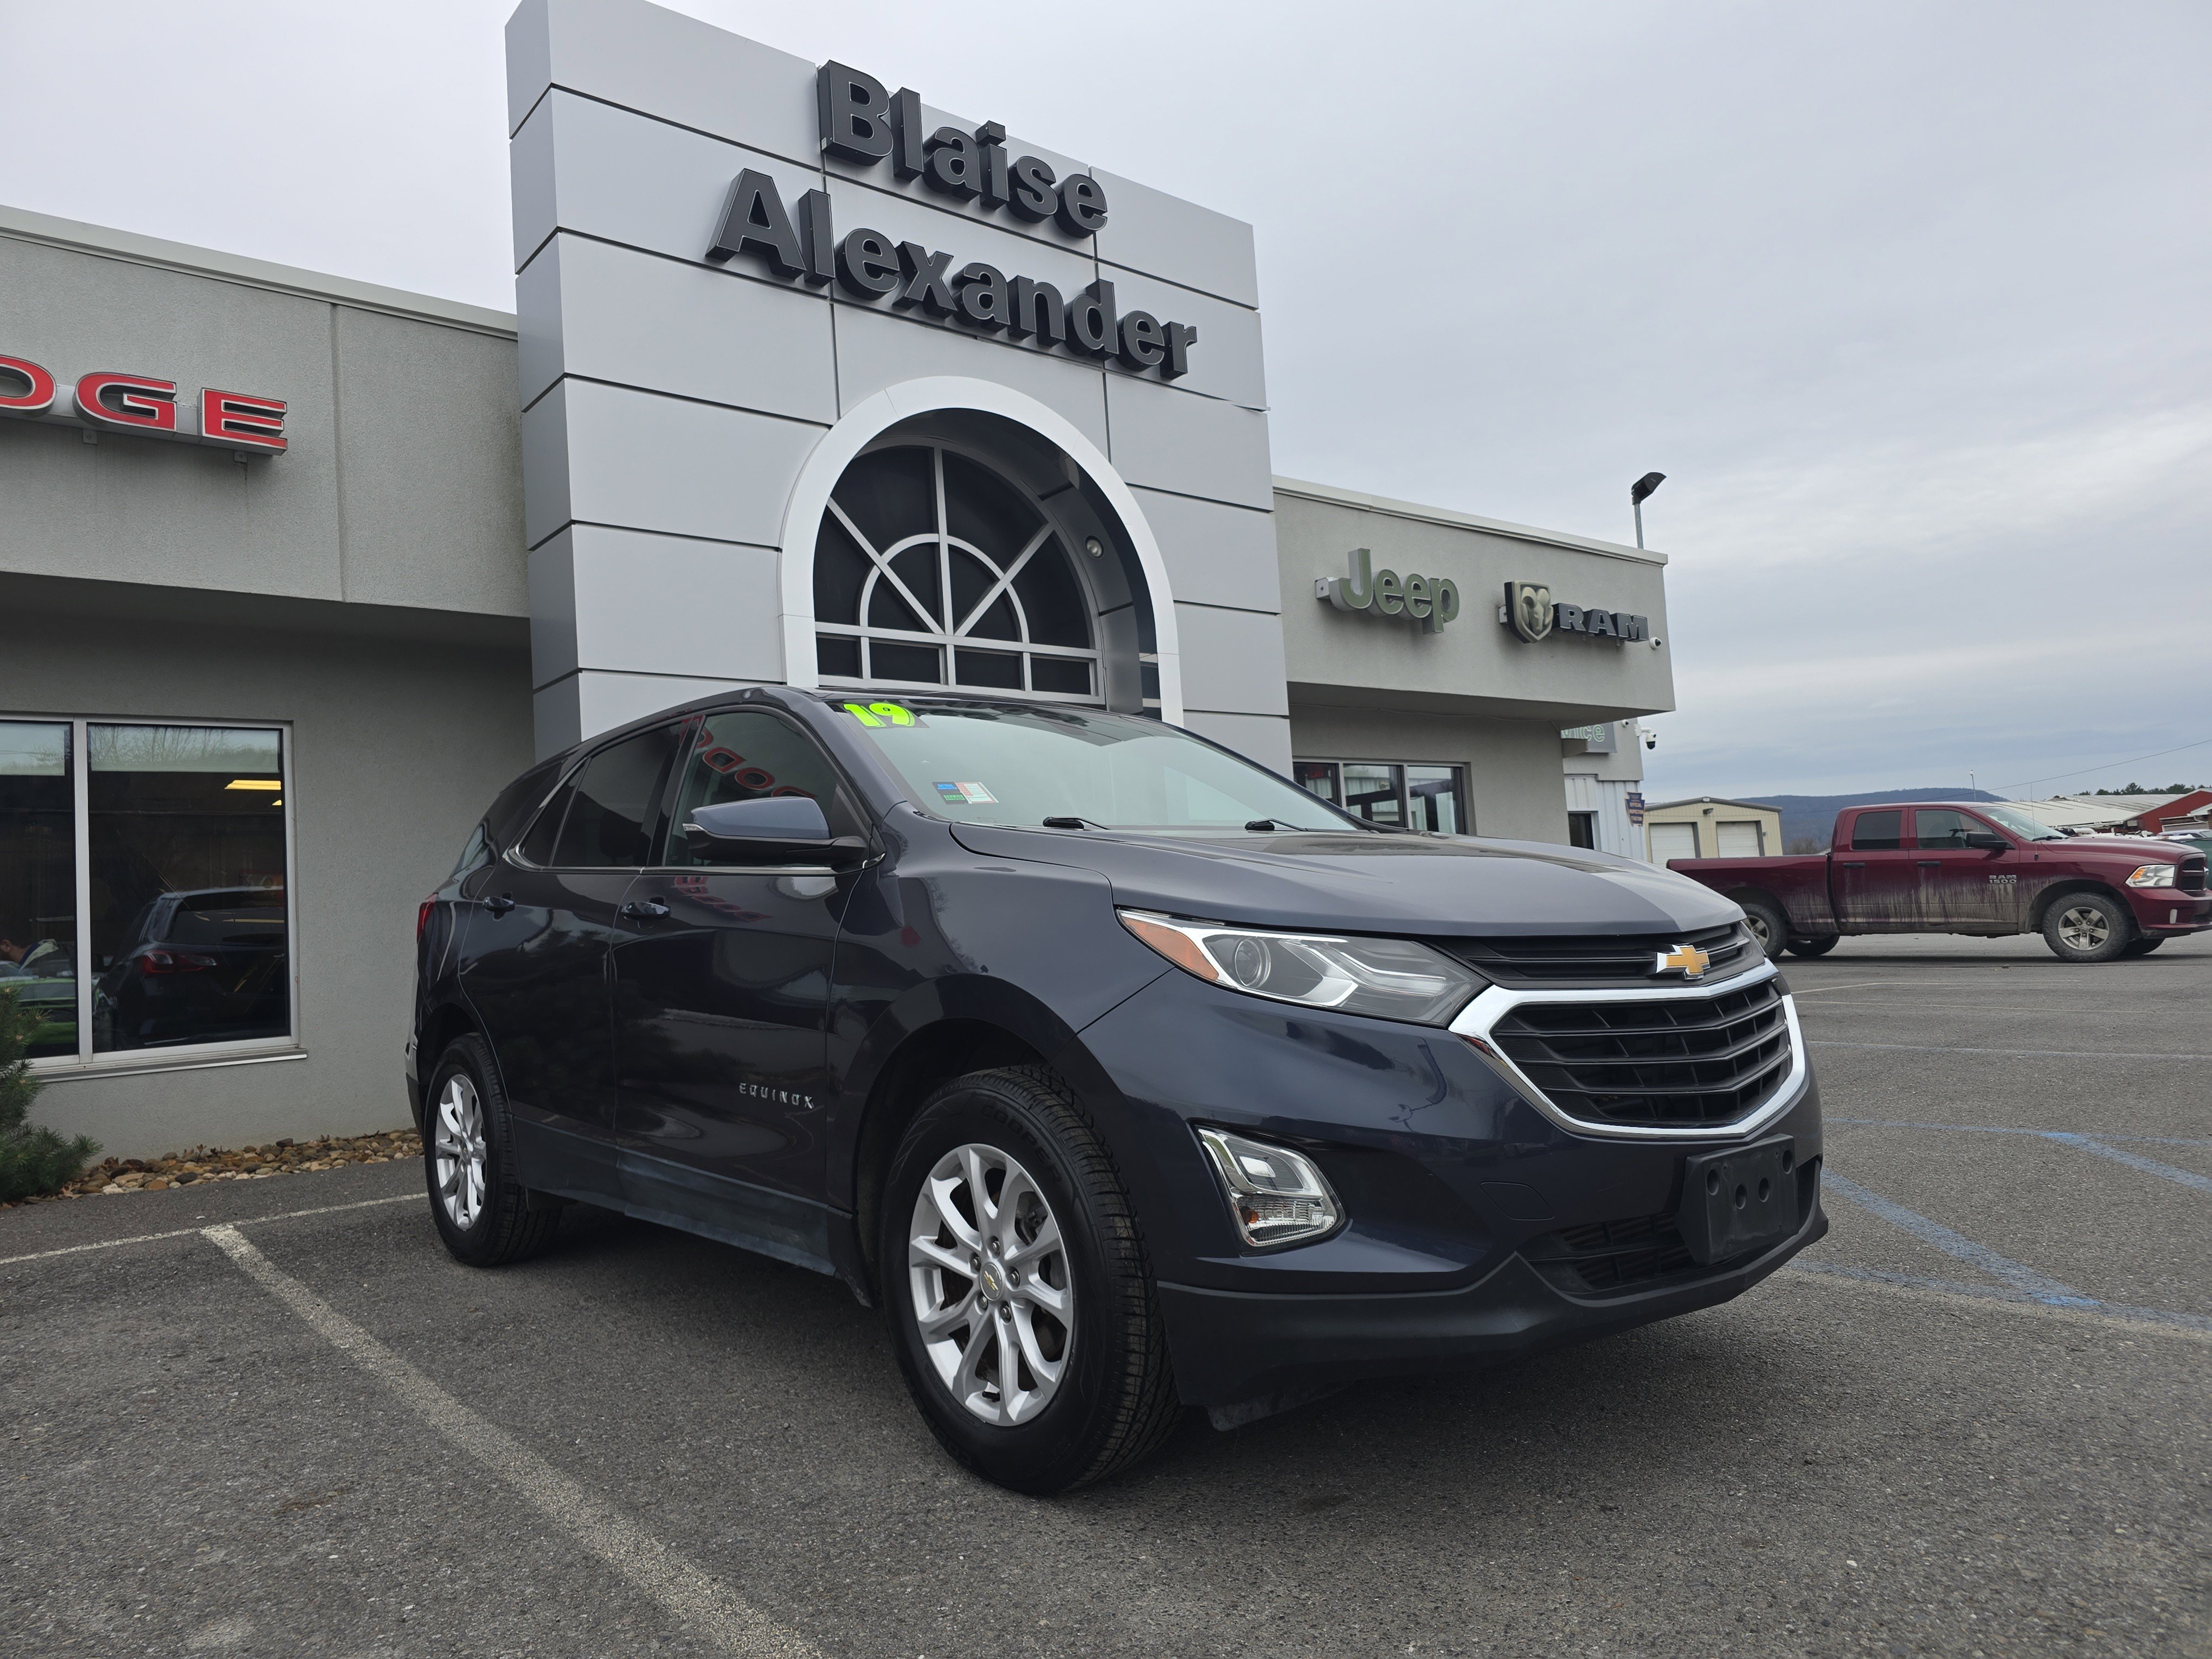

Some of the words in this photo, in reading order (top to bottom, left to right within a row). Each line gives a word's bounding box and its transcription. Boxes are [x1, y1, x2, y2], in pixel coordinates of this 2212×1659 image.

[817, 60, 1108, 238] Blaise
[705, 168, 1197, 380] Alexander
[1330, 548, 1459, 633] Jeep
[1553, 602, 1649, 642] RAM
[844, 703, 915, 727] 19
[739, 1082, 814, 1109] EQUINOX
[980, 1104, 1063, 1186] COOPER
